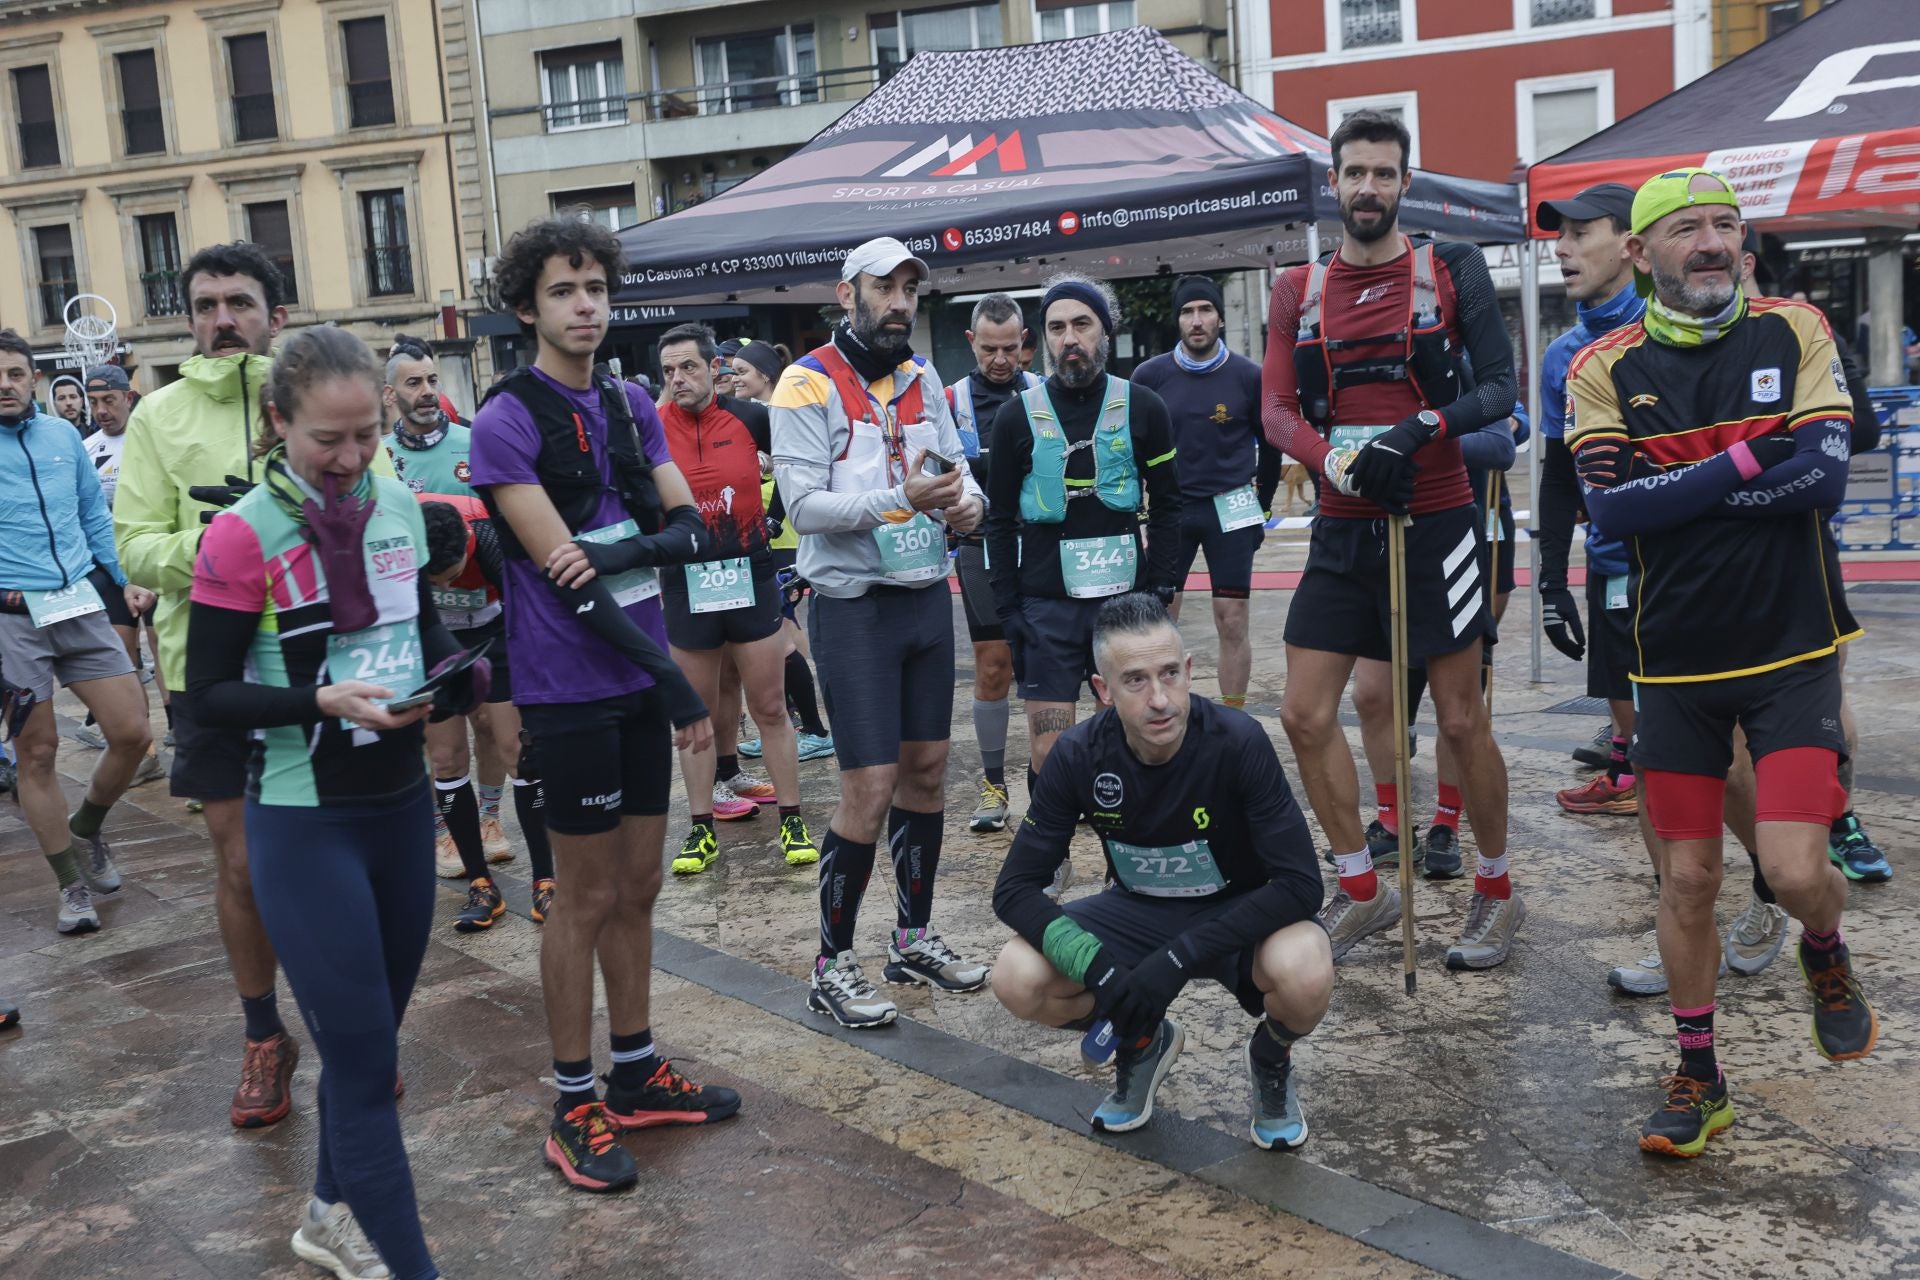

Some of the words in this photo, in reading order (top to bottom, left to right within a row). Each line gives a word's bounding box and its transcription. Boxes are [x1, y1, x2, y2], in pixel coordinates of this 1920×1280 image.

[1721, 148, 1791, 165] CHANGES
[1728, 162, 1784, 179] STARTS
[832, 186, 916, 199] SPORT
[922, 185, 937, 196] &
[947, 176, 1045, 194] CASUAL
[1750, 178, 1777, 191] THE
[867, 195, 978, 211] VILLAVICIOSA
[1738, 193, 1773, 207] SIDE
[647, 266, 693, 283] Casona
[711, 264, 719, 276] 4
[721, 259, 740, 274] CP
[742, 254, 784, 271] 33300
[785, 247, 854, 267] Villavicios
[965, 219, 1051, 246] 653937484
[1082, 187, 1298, 228] info@mmsportcasual.com
[625, 309, 637, 321] LA
[641, 306, 676, 318] VILLA
[1226, 491, 1256, 511] 382
[891, 527, 931, 553] 360
[1075, 547, 1124, 571] 344
[699, 568, 738, 589] 209
[432, 591, 470, 607] 383
[349, 640, 415, 680] 244
[1130, 856, 1193, 874] 272
